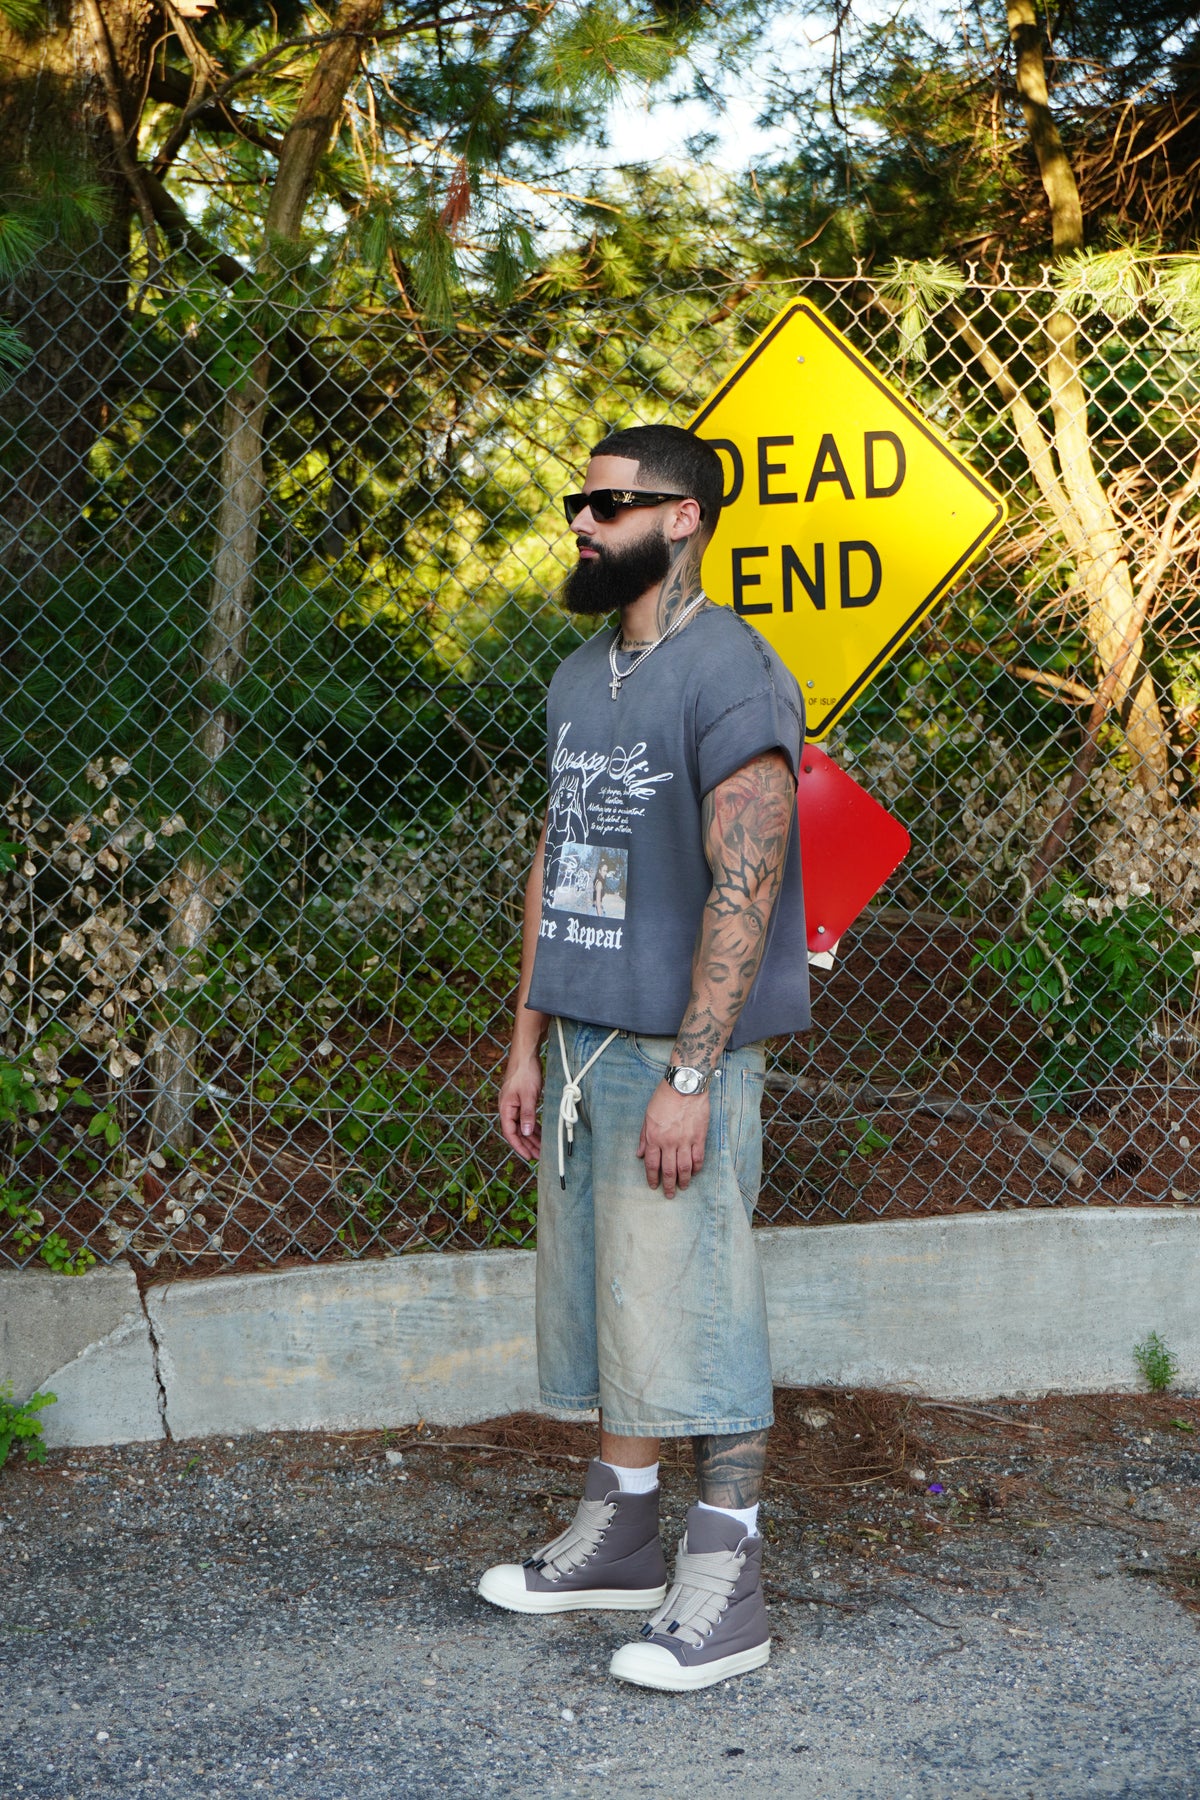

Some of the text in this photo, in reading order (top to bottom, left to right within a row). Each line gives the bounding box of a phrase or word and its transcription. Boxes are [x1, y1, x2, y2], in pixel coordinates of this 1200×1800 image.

[702, 430, 906, 508] DEAD
[731, 540, 882, 615] END
[808, 697, 817, 706] OF
[563, 917, 624, 950] Repeat
